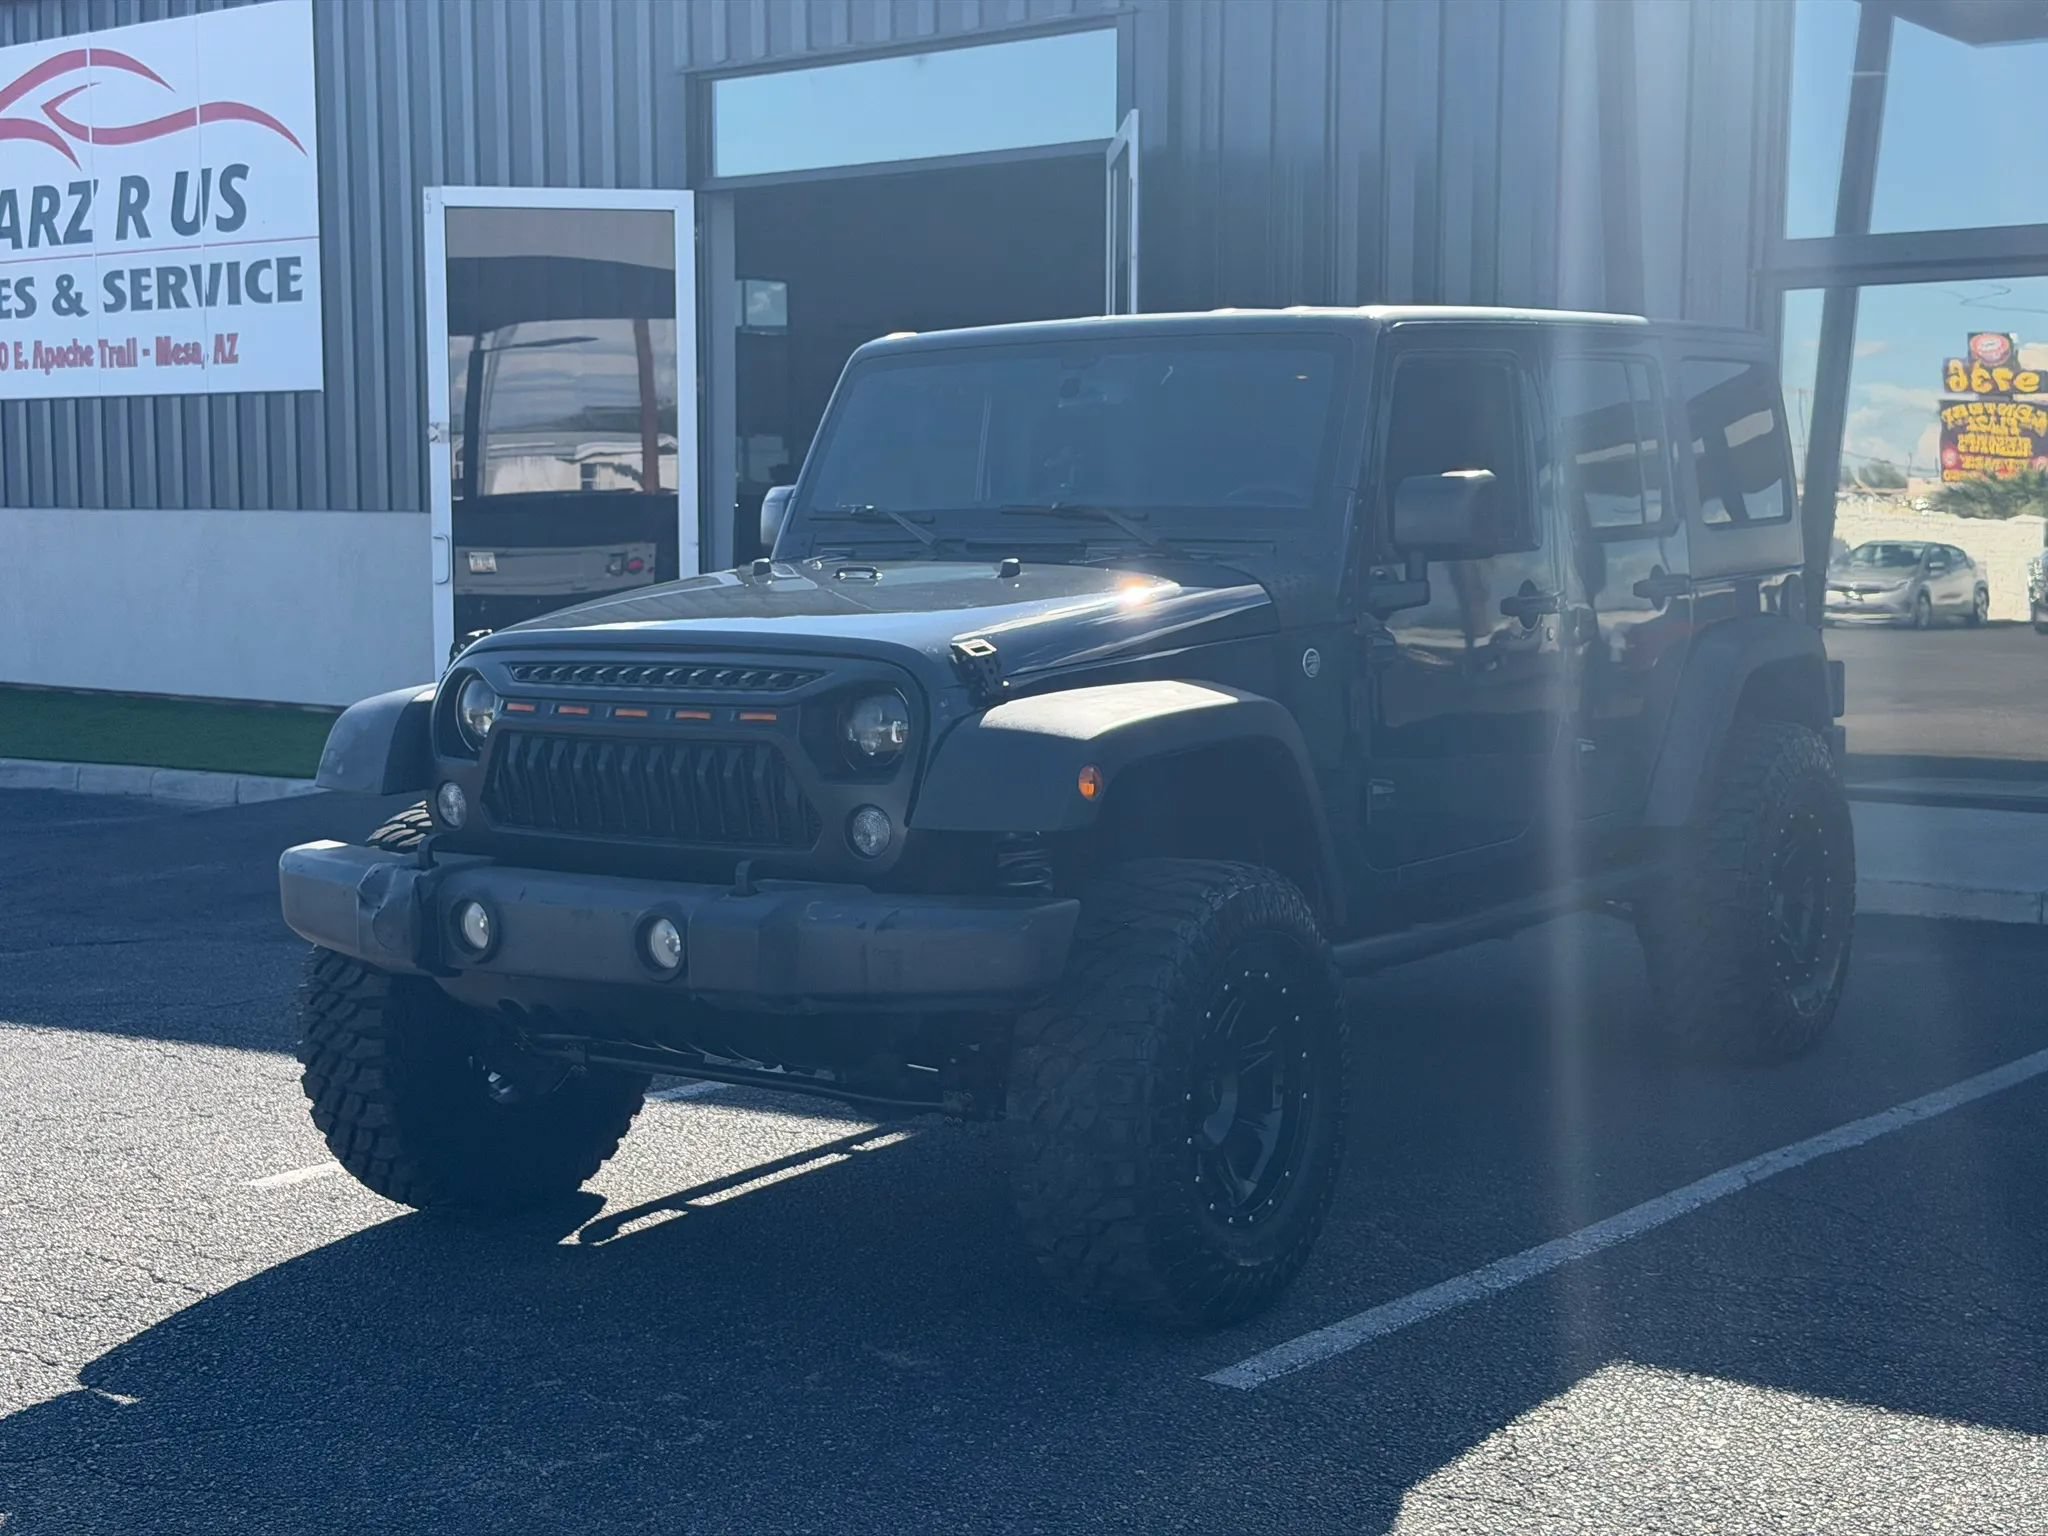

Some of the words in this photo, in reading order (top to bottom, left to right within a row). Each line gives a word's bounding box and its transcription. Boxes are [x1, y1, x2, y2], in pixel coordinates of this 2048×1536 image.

[115, 175, 152, 241] R
[170, 163, 250, 237] US
[52, 273, 89, 318] &
[102, 256, 303, 313] SERVICE
[13, 341, 29, 370] E.
[32, 338, 94, 375] Apache
[98, 337, 138, 368] Trail
[213, 333, 239, 365] AZ
